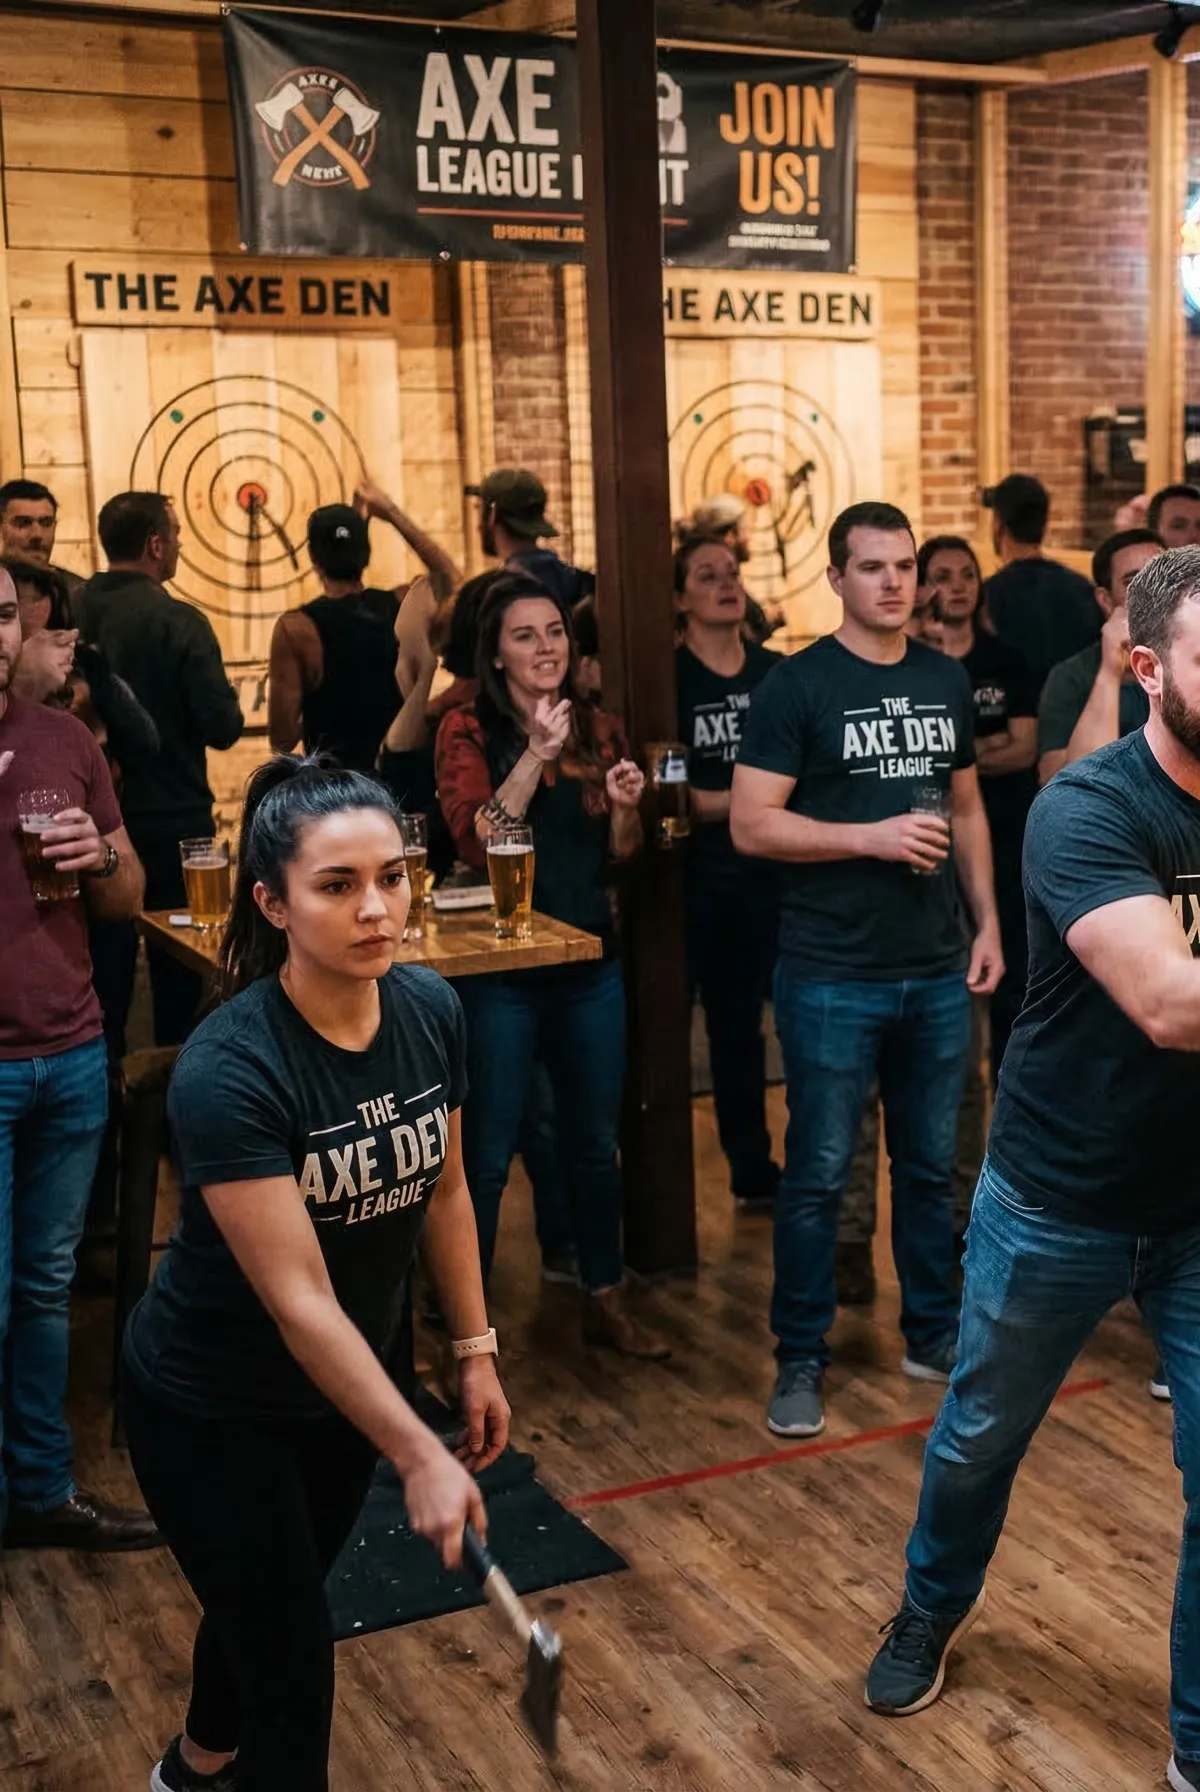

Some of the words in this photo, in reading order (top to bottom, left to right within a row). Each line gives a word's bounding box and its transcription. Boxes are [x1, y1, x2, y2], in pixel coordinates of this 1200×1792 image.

[416, 52, 559, 147] AXE
[719, 81, 836, 150] JOIN
[416, 145, 562, 199] LEAGUE
[738, 150, 820, 216] US!
[85, 272, 180, 312] THE
[194, 275, 286, 316] AXE
[300, 278, 391, 318] DEN
[662, 287, 700, 321] HE
[714, 288, 785, 323] AXE
[799, 290, 872, 325] DEN
[693, 711, 742, 748] AXE
[881, 697, 913, 717] THE
[842, 719, 899, 760] AXE
[902, 716, 956, 753] DEN
[879, 756, 934, 779] LEAGUE
[357, 1092, 401, 1129] THE
[298, 1136, 383, 1204] AXE
[390, 1101, 449, 1181] DEN
[346, 1178, 426, 1225] LEAGUE
